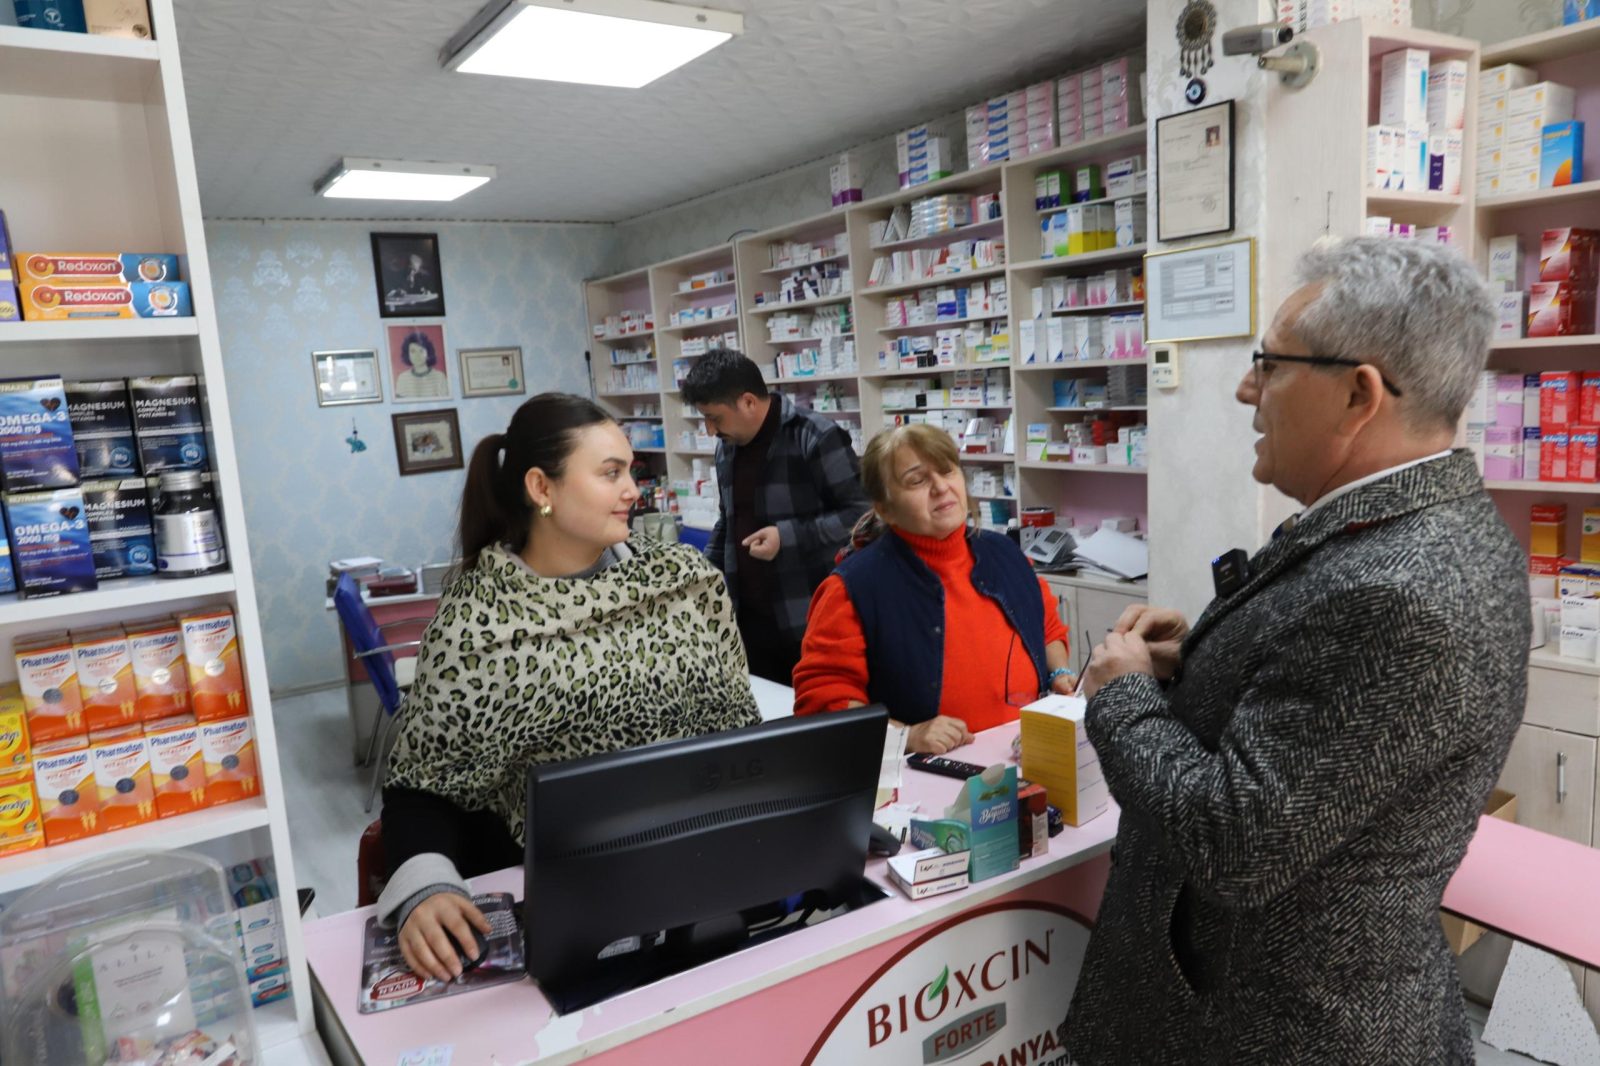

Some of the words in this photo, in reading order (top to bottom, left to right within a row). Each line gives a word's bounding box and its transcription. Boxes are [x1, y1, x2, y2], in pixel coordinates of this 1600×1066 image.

[57, 261, 116, 271] Redoxon
[64, 290, 125, 302] Redoxon
[136, 397, 196, 408] MAGNESIUM
[0, 411, 66, 427] OMEGA-3
[25, 424, 42, 434] mg
[84, 499, 145, 511] MAGNESIUM
[15, 519, 84, 537] OMEGA-3
[17, 535, 41, 545] 2000
[43, 534, 60, 544] mg
[186, 619, 232, 633] Pharmaton
[133, 635, 178, 649] Pharmaton
[77, 644, 126, 658] Pharmaton
[21, 653, 71, 669] Pharmaton
[203, 721, 248, 737] Pharmaton
[150, 731, 197, 746] Pharmaton
[96, 743, 144, 759] Pharmaton
[37, 752, 88, 770] Pharmaton
[867, 929, 1050, 1048] BIOXCIN
[934, 1009, 997, 1057] FORTE
[979, 1029, 1064, 1066] ANYA
